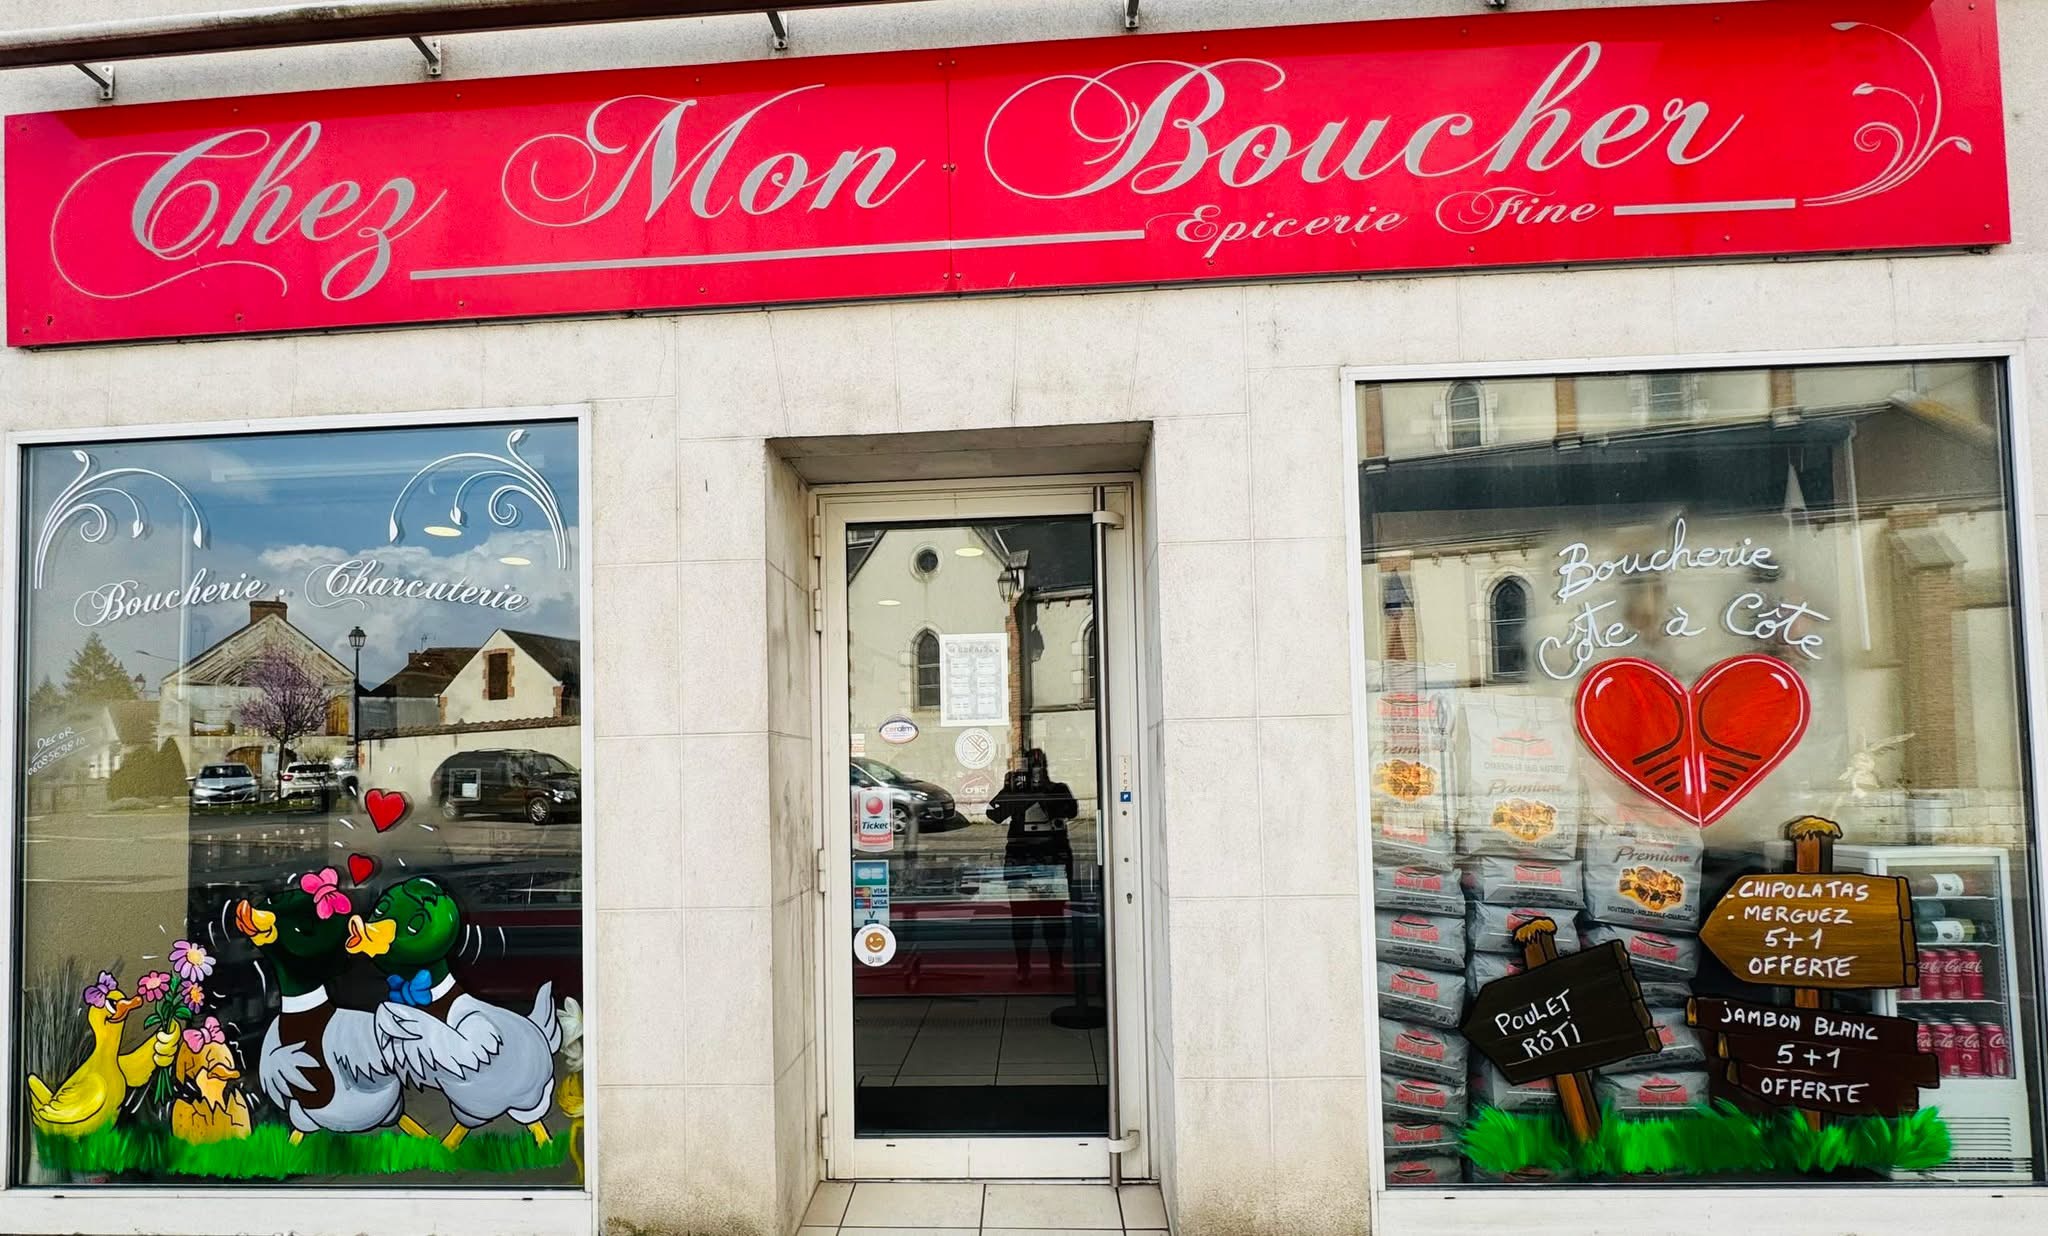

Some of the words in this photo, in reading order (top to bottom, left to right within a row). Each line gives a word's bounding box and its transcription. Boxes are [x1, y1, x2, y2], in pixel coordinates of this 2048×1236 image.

[51, 121, 447, 301] Chez
[502, 83, 926, 227] Mon
[984, 41, 1745, 200] Boucher
[1146, 204, 1408, 259] Epicerie
[1435, 187, 1604, 235] Fine
[1557, 518, 1779, 602] Boucherie
[73, 567, 267, 627] Boucherie
[304, 559, 529, 612] Charcuterie
[1665, 606, 1707, 638] à
[1738, 880, 1870, 902] CHIPOLATAS
[1744, 905, 1853, 924] MERGUEZ
[1748, 955, 1859, 979] OFFERTE
[1494, 988, 1570, 1036] POULET
[1814, 1016, 1879, 1041] BLANC
[1760, 1077, 1870, 1103] OFFERTE
